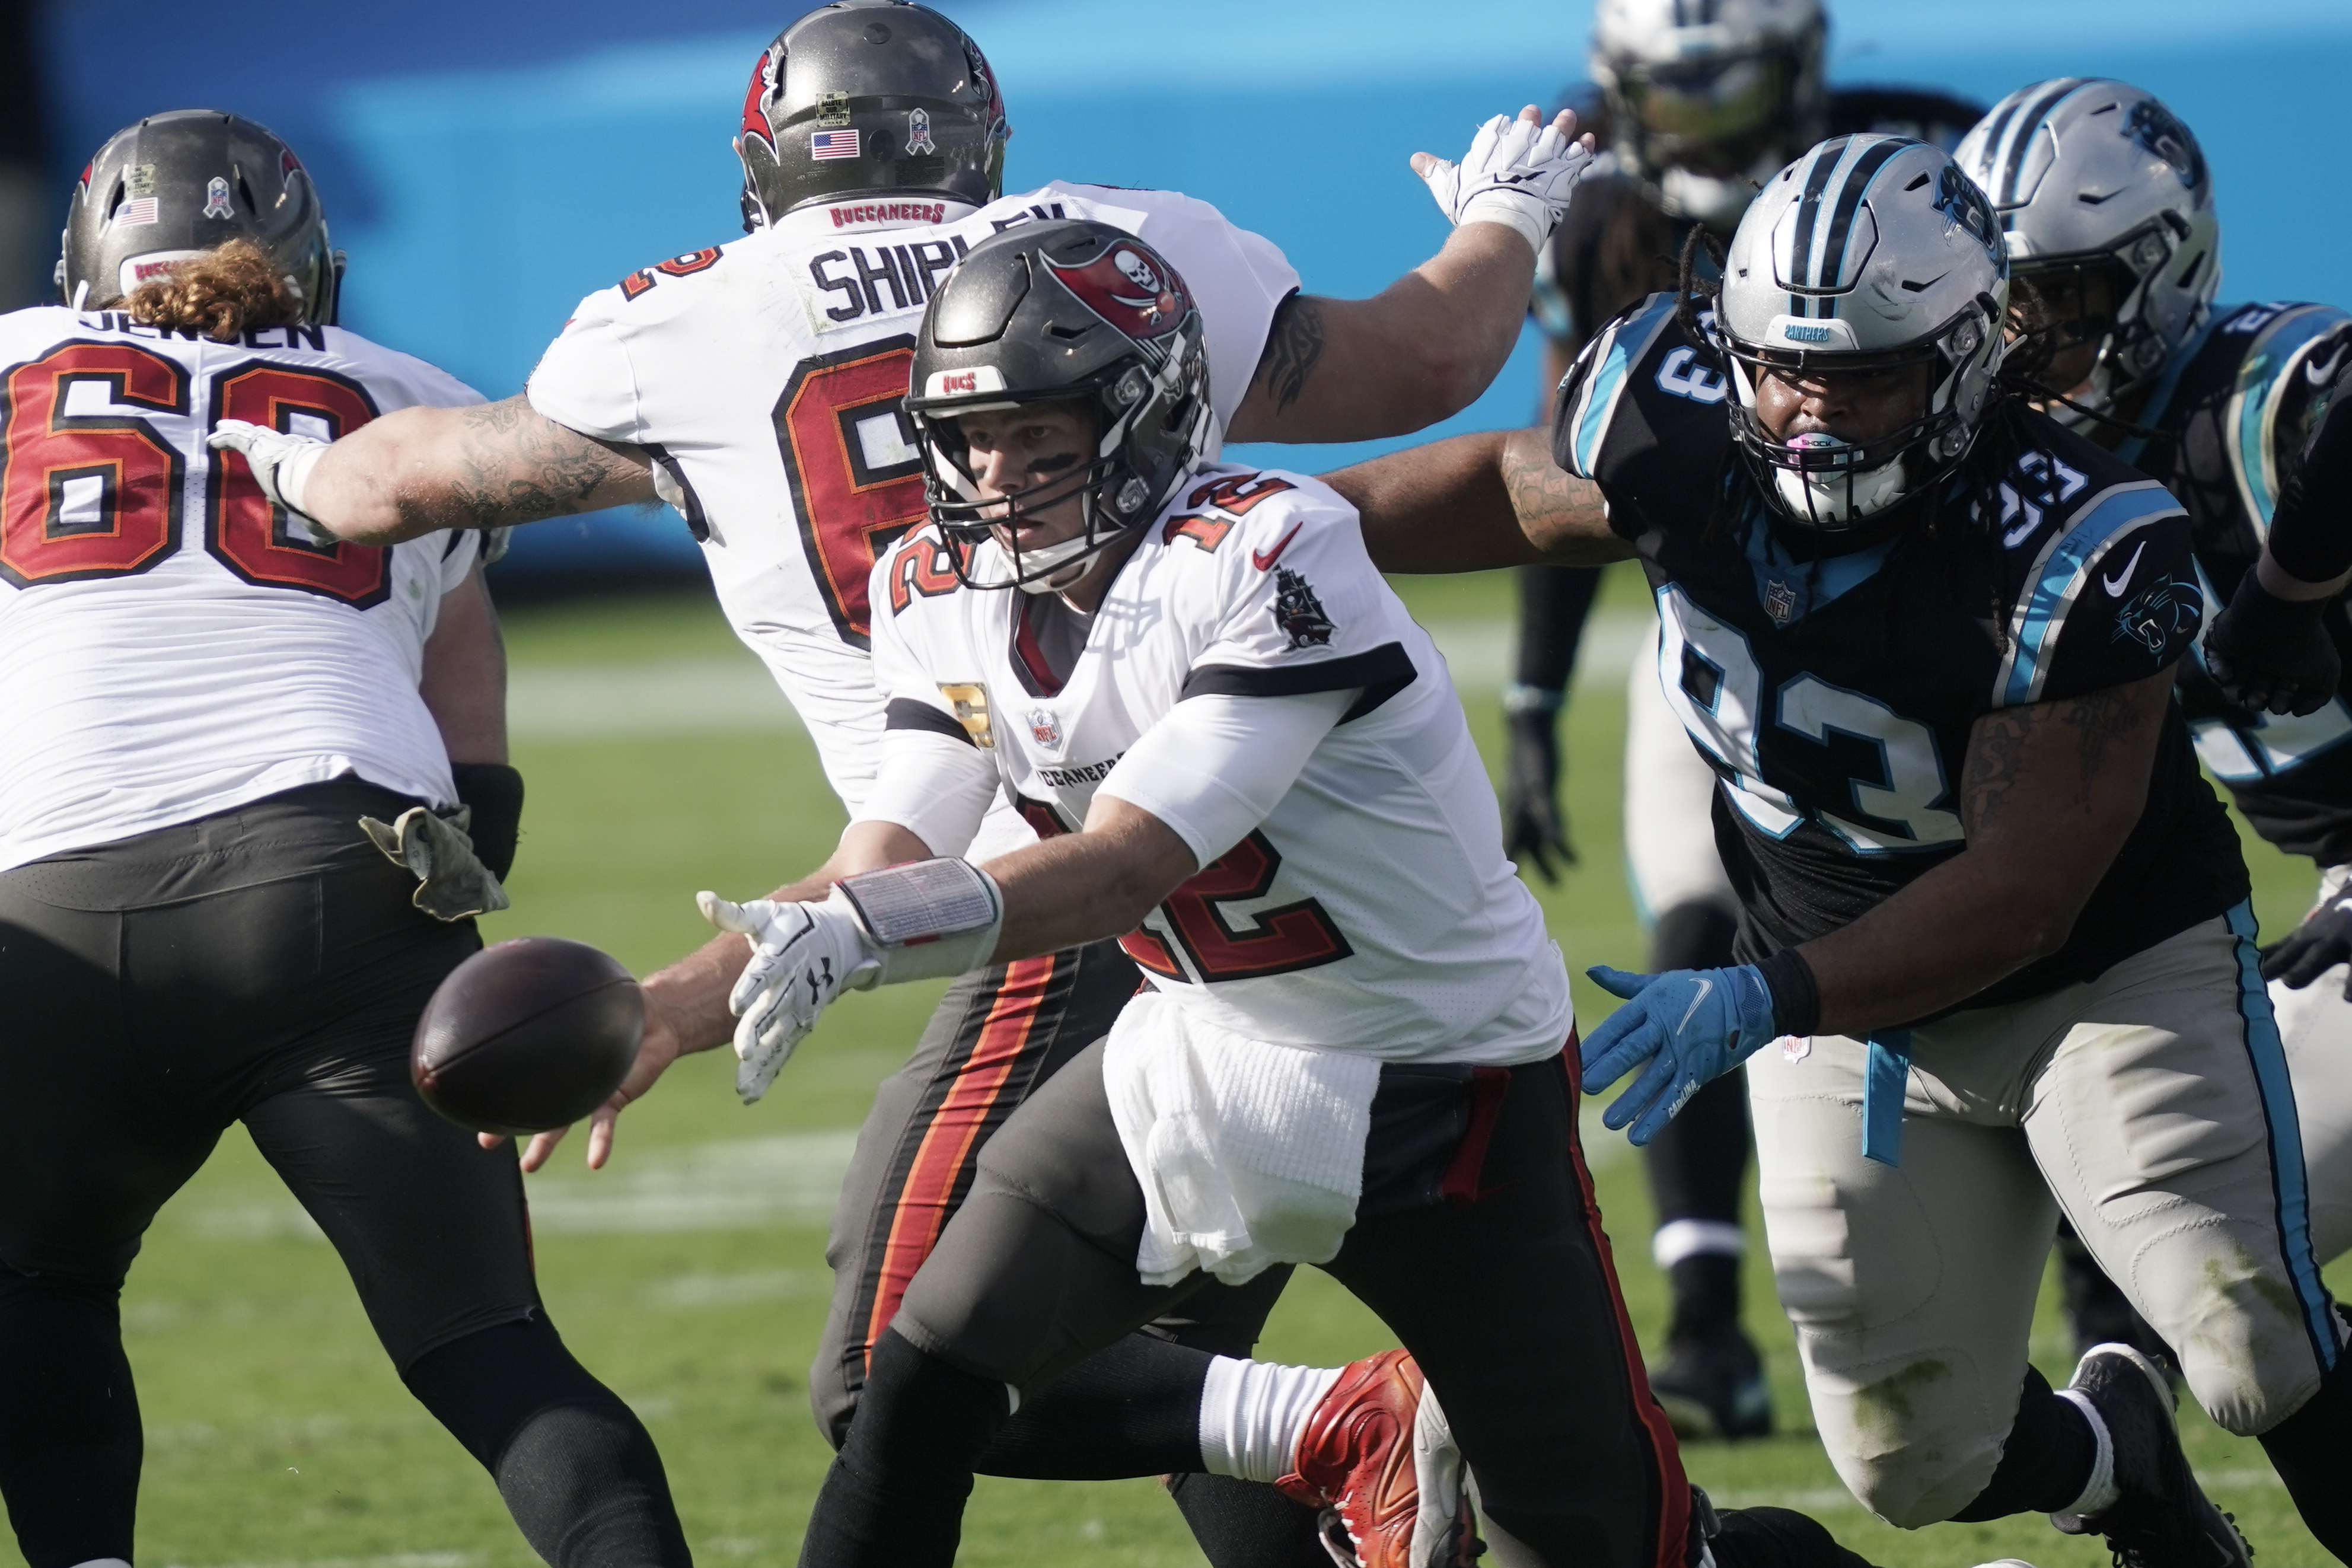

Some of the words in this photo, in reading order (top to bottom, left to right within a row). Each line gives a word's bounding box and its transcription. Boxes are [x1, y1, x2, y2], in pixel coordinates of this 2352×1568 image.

[913, 130, 927, 141] NFL
[212, 196, 227, 206] NFL
[828, 203, 946, 228] BUCCANEERS
[809, 203, 1066, 321] SHIP
[1784, 324, 1831, 342] PANTHERS
[1161, 470, 1299, 553] 12
[1769, 597, 1787, 618] NFL
[1657, 580, 1968, 855] 93
[1033, 725, 1057, 742] NFL
